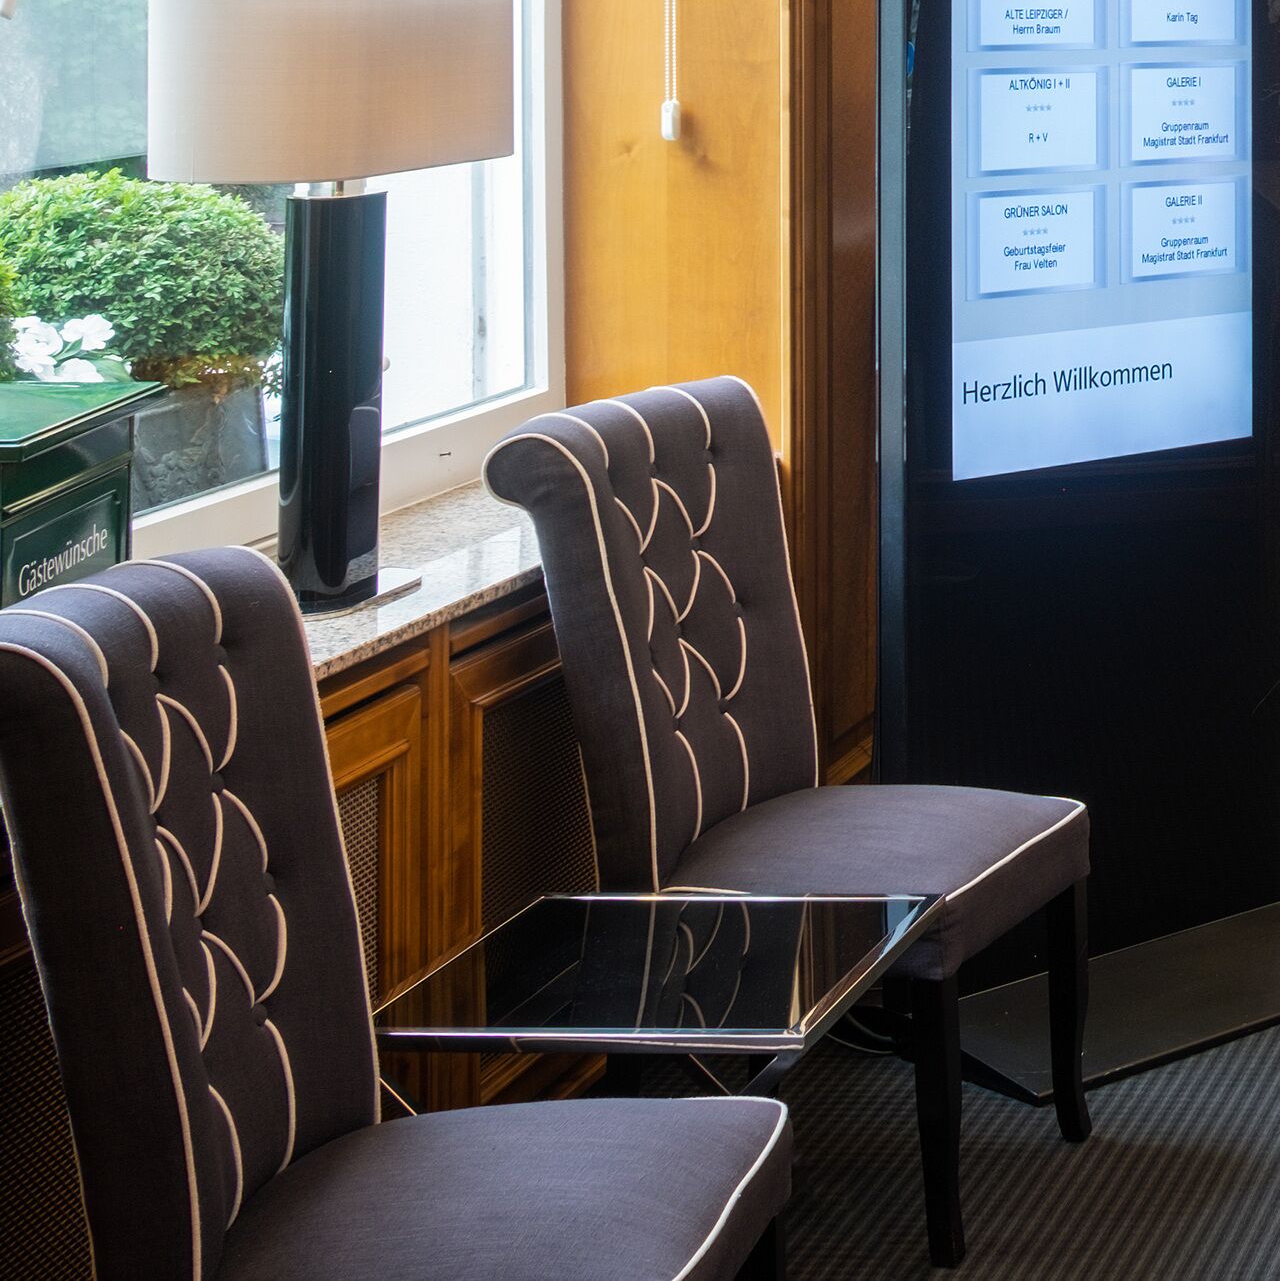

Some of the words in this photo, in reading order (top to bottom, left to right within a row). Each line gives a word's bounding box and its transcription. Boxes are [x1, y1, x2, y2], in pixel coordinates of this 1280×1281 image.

[1005, 9, 1024, 20] ALTE
[1025, 9, 1063, 20] LEIPZIGER
[1166, 12, 1184, 22] Karin
[1186, 12, 1198, 24] Tag
[1012, 24, 1034, 35] Herrn
[1009, 77, 1052, 90] ALTKÖNIG
[1065, 78, 1070, 88] II
[1166, 76, 1197, 88] GALERIE
[1161, 122, 1209, 133] Gruppenraum
[1028, 132, 1034, 143] R
[1042, 132, 1048, 142] V
[1143, 137, 1177, 149] Magistrat
[1178, 135, 1196, 145] Stadt
[1197, 133, 1229, 144] Frankfurt
[1165, 195, 1196, 207] GALERIE
[1198, 195, 1202, 205] II
[1004, 205, 1040, 219] GRÜNER
[1041, 204, 1068, 216] SALON
[1160, 236, 1209, 249] Gruppenraum
[1003, 242, 1066, 257] Geburtstagsfeier
[1141, 253, 1175, 265] Magistrat
[1176, 250, 1195, 260] Stadt
[1196, 247, 1228, 259] Frankfurt
[1014, 260, 1031, 271] Frau
[1033, 258, 1058, 269] Velten
[963, 372, 1047, 405] Herzlich
[1053, 362, 1173, 393] Willkommen
[19, 523, 108, 596] Gästewünsche
